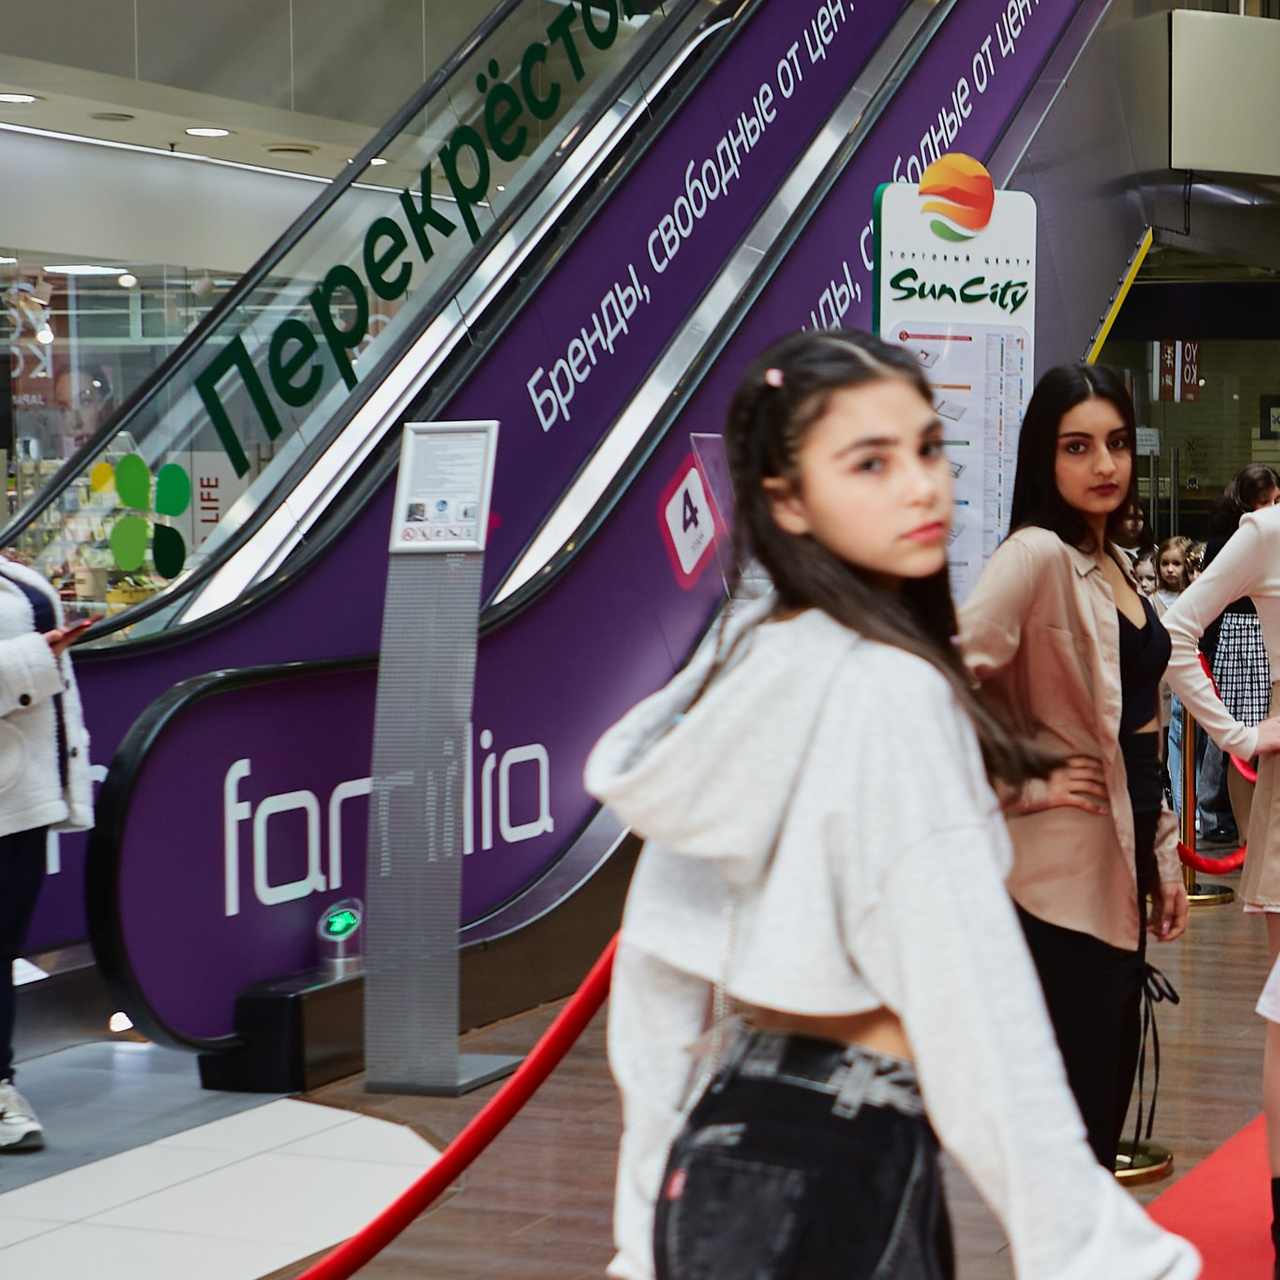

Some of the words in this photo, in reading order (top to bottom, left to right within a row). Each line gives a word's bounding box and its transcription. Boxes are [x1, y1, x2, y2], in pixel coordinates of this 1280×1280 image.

[972, 35, 996, 94] от
[527, 263, 650, 433] Бренды,
[647, 83, 777, 273] свободные
[777, 41, 803, 99] от
[200, 476, 219, 524] LIFE
[683, 488, 699, 533] 4
